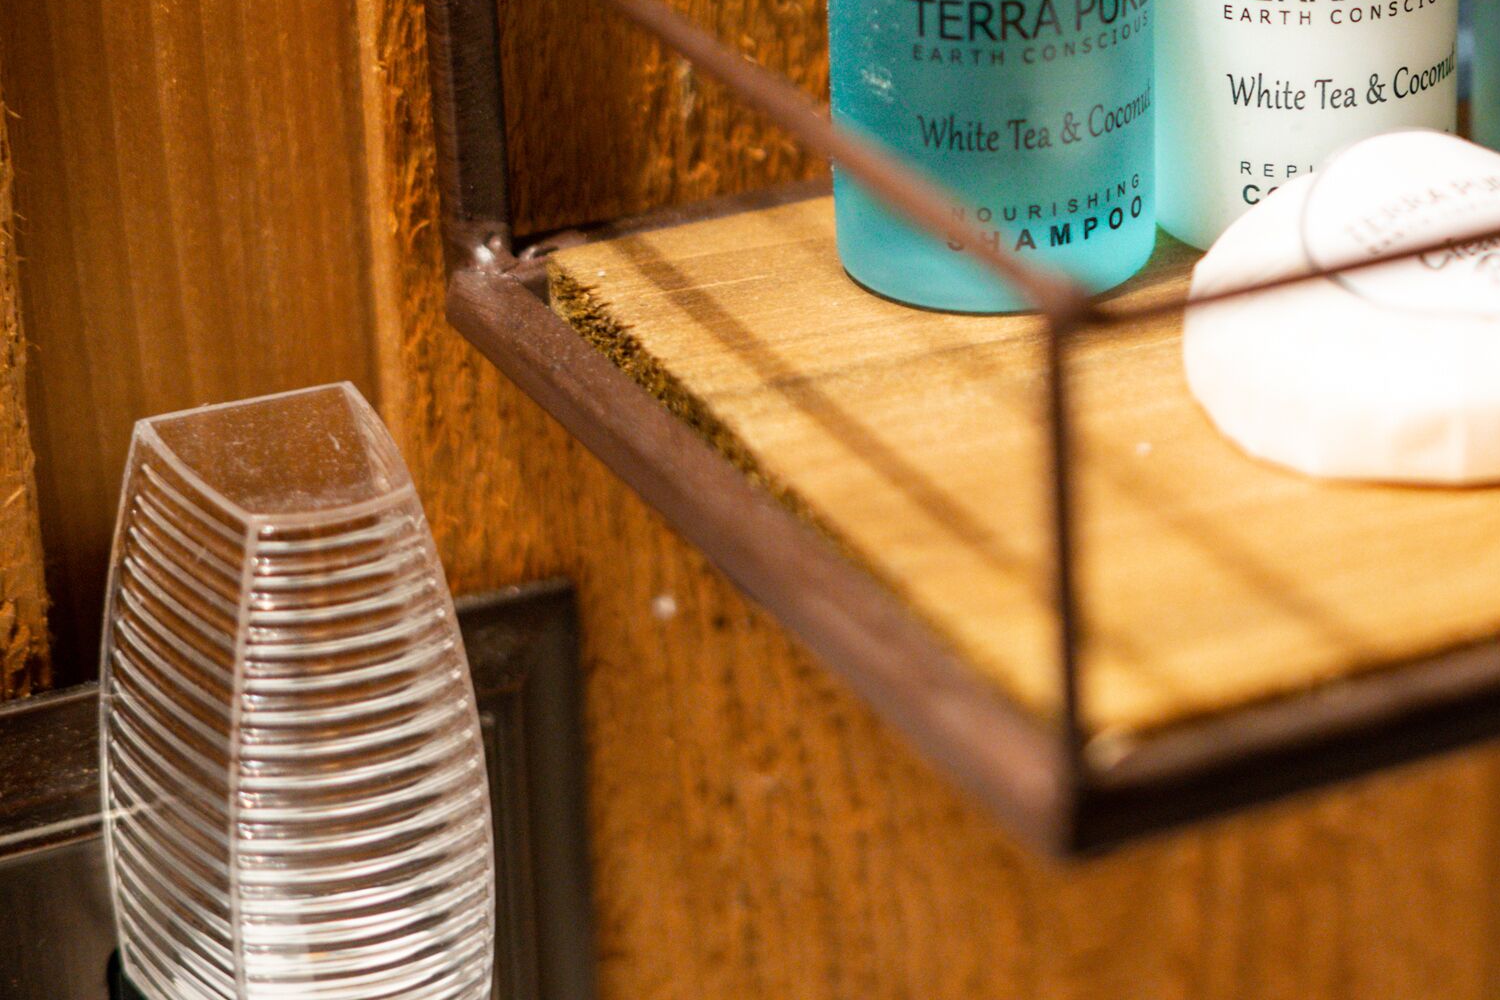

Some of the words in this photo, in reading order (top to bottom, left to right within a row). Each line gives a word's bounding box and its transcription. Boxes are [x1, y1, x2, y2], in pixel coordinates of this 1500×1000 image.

[1223, 3, 1312, 25] EARTH
[913, 44, 1005, 66] EARTH
[1022, 13, 1149, 65] CONSCIOUS
[1226, 72, 1306, 110] White
[1314, 78, 1358, 110] Tea
[1366, 73, 1388, 105] &
[917, 114, 1000, 152] White
[1007, 118, 1052, 152] Tea
[1060, 111, 1082, 145] &
[952, 173, 1140, 222] NOURISHING
